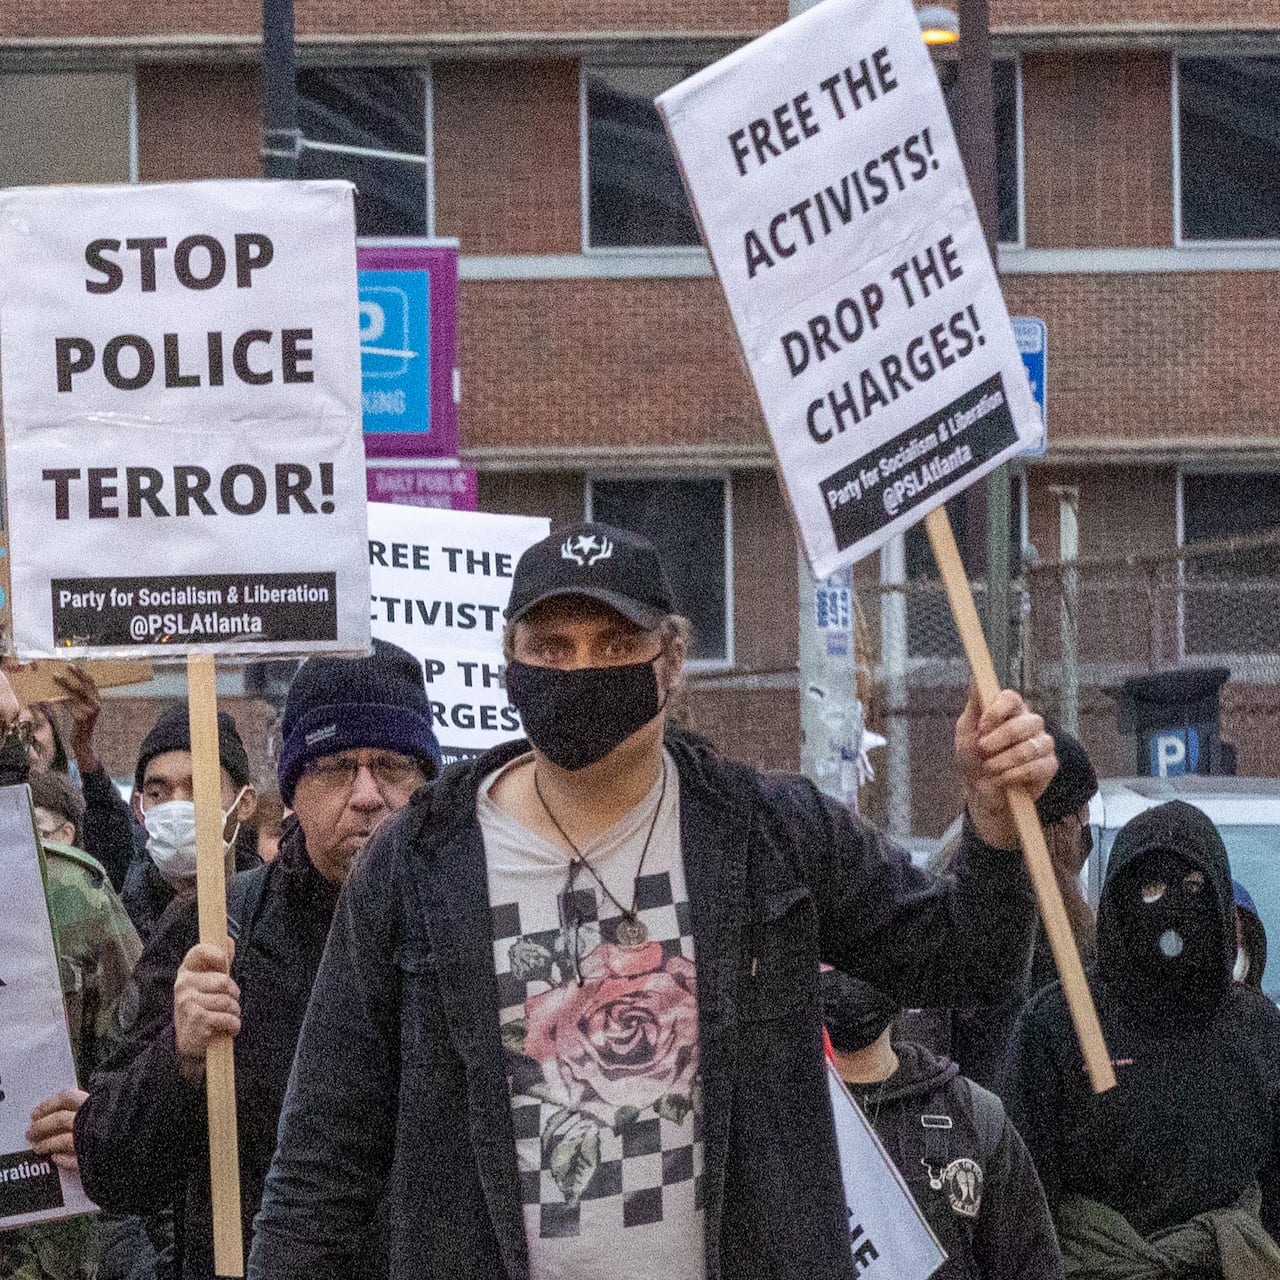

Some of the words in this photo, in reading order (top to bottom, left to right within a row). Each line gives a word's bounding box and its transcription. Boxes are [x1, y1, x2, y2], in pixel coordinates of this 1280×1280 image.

[728, 88, 822, 175] FREE
[821, 47, 898, 122] THE
[742, 128, 939, 278] ACTIVISTS!
[85, 232, 274, 294] STOP
[781, 282, 885, 378] DROP
[891, 234, 964, 303] THE
[54, 329, 315, 392] POLICE
[806, 304, 985, 445] CHARGES!
[827, 479, 862, 510] Party
[860, 467, 880, 490] for
[879, 433, 938, 477] Socialism
[948, 390, 1005, 436] Liberation
[883, 444, 973, 515] @PSLAtlanta
[42, 462, 336, 520] TERROR!
[441, 547, 513, 578] THE
[60, 588, 103, 609] Party
[109, 586, 132, 606] for
[138, 584, 222, 608] Socialism
[228, 586, 238, 603] &
[244, 582, 328, 604] Liberation
[131, 612, 262, 639] @PSLAtlanta
[371, 595, 508, 632] TIVIST
[1156, 732, 1186, 775] P
